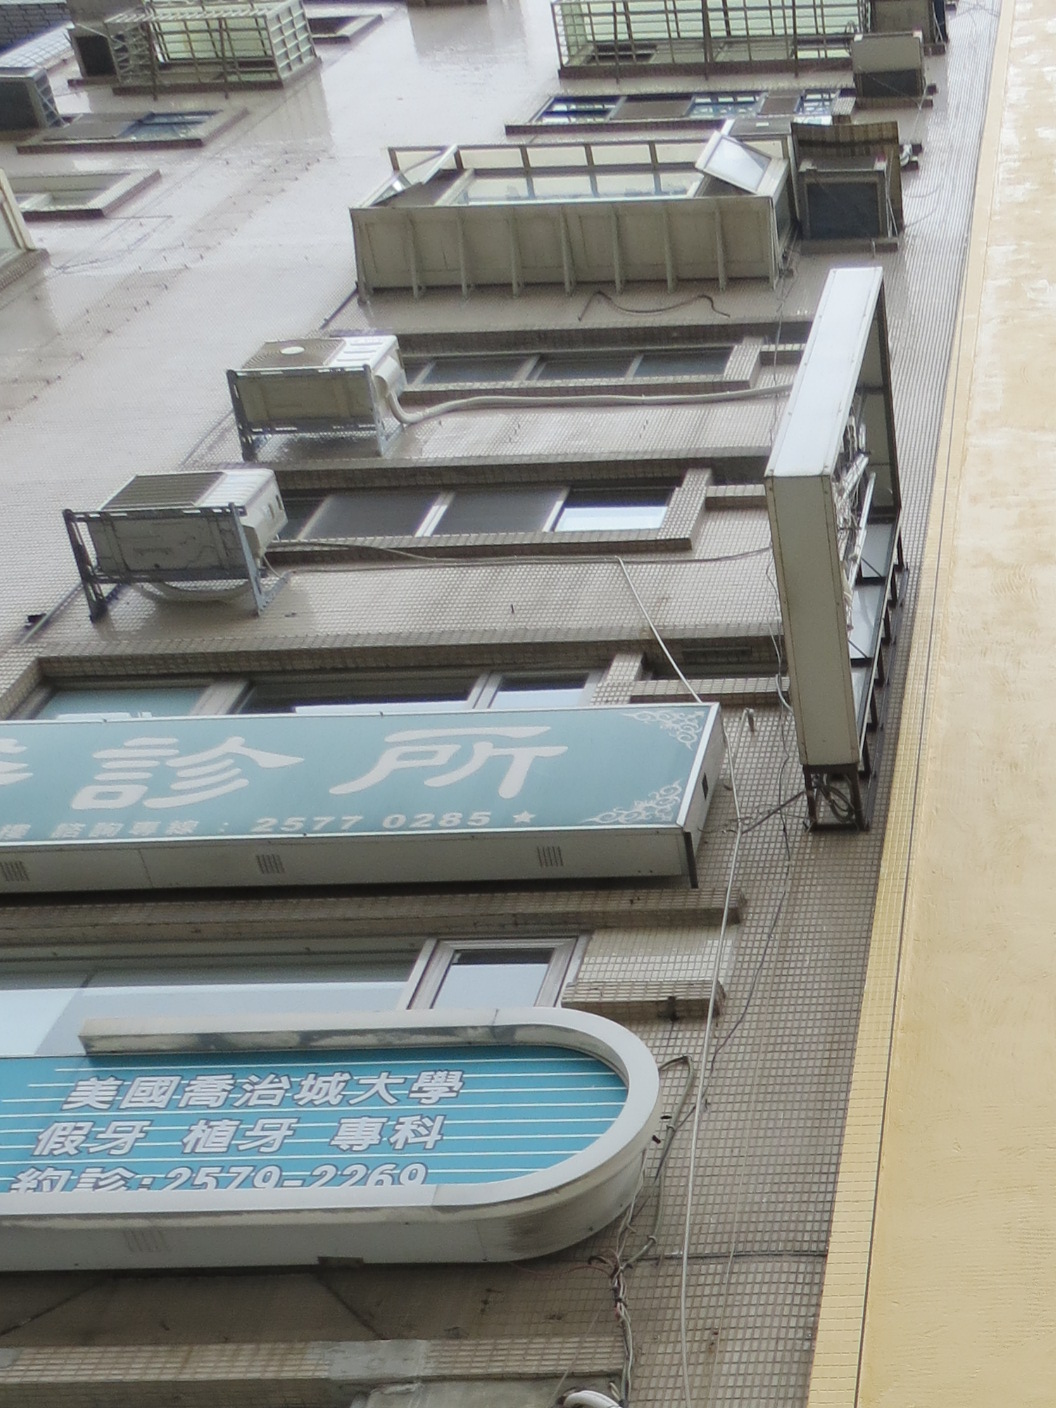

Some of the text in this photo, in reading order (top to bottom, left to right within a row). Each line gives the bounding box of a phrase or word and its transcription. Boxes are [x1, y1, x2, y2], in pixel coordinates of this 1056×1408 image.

[251, 815, 364, 834] 2577
[382, 811, 491, 830] 0285
[61, 1070, 464, 1111] 美國喬治城大學
[30, 1114, 446, 1157] 假牙 植牙 專科
